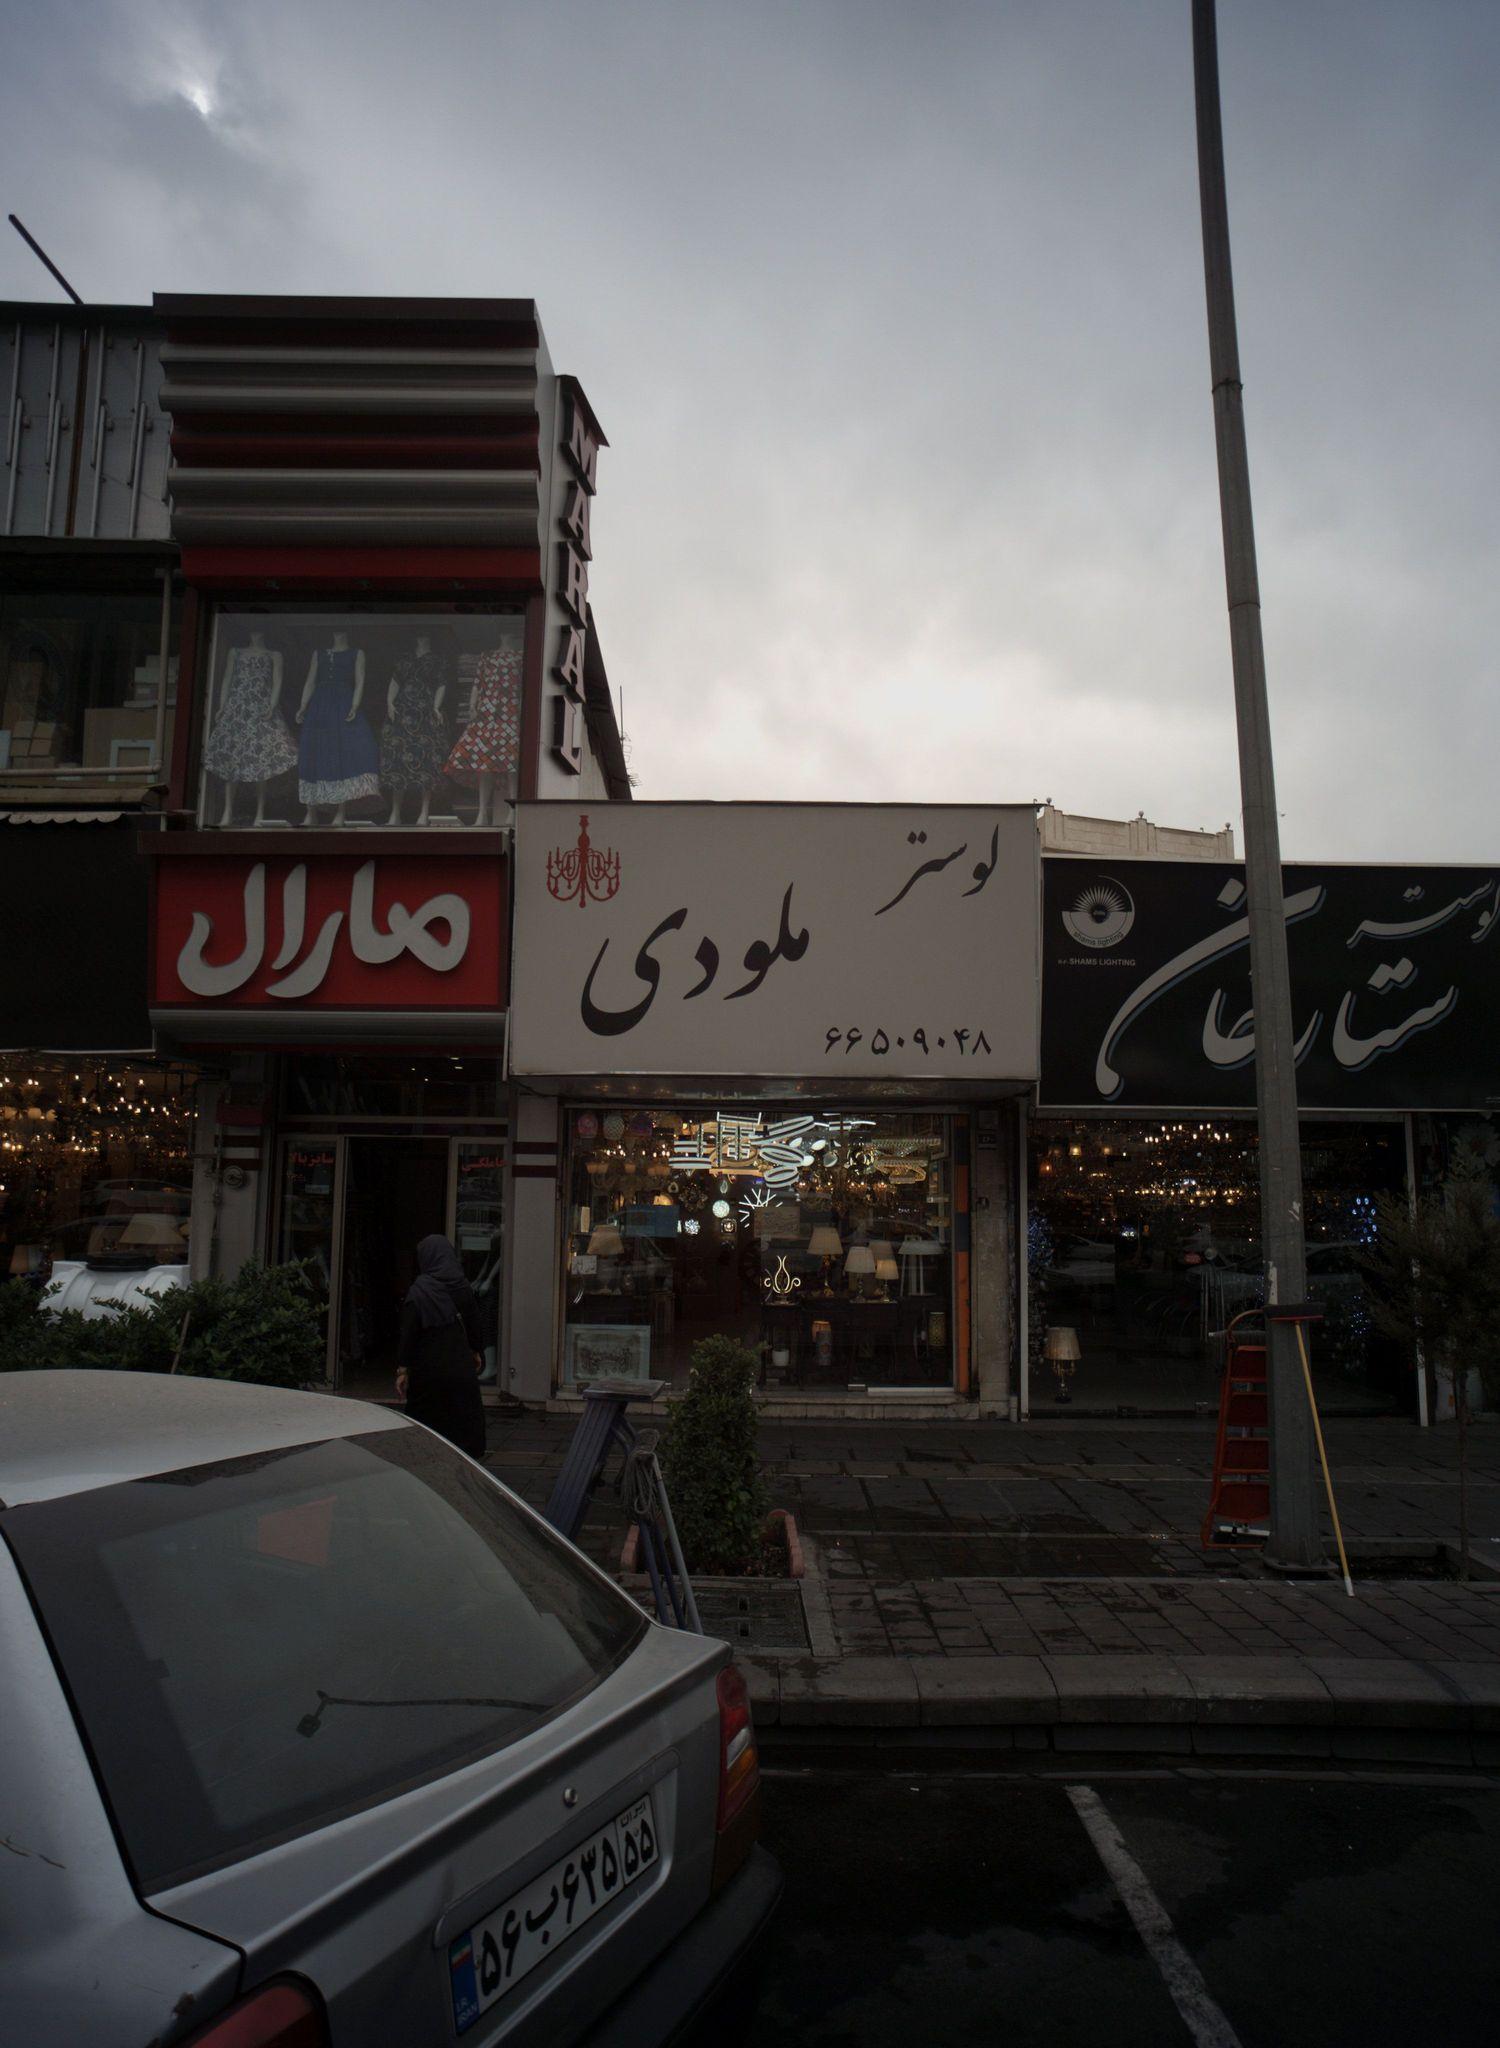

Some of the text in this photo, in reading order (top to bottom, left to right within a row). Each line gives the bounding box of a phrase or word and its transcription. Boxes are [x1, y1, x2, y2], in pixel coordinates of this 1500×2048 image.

[561, 392, 598, 775] MARAL
[875, 824, 1000, 917] لوستر
[177, 859, 471, 999] مارال
[581, 882, 811, 1037] ملودی
[1069, 957, 1097, 966] SHAMS
[1099, 957, 1136, 967] LIGHTING
[824, 1027, 992, 1055] ۶۶۵۰۹۰۴۸
